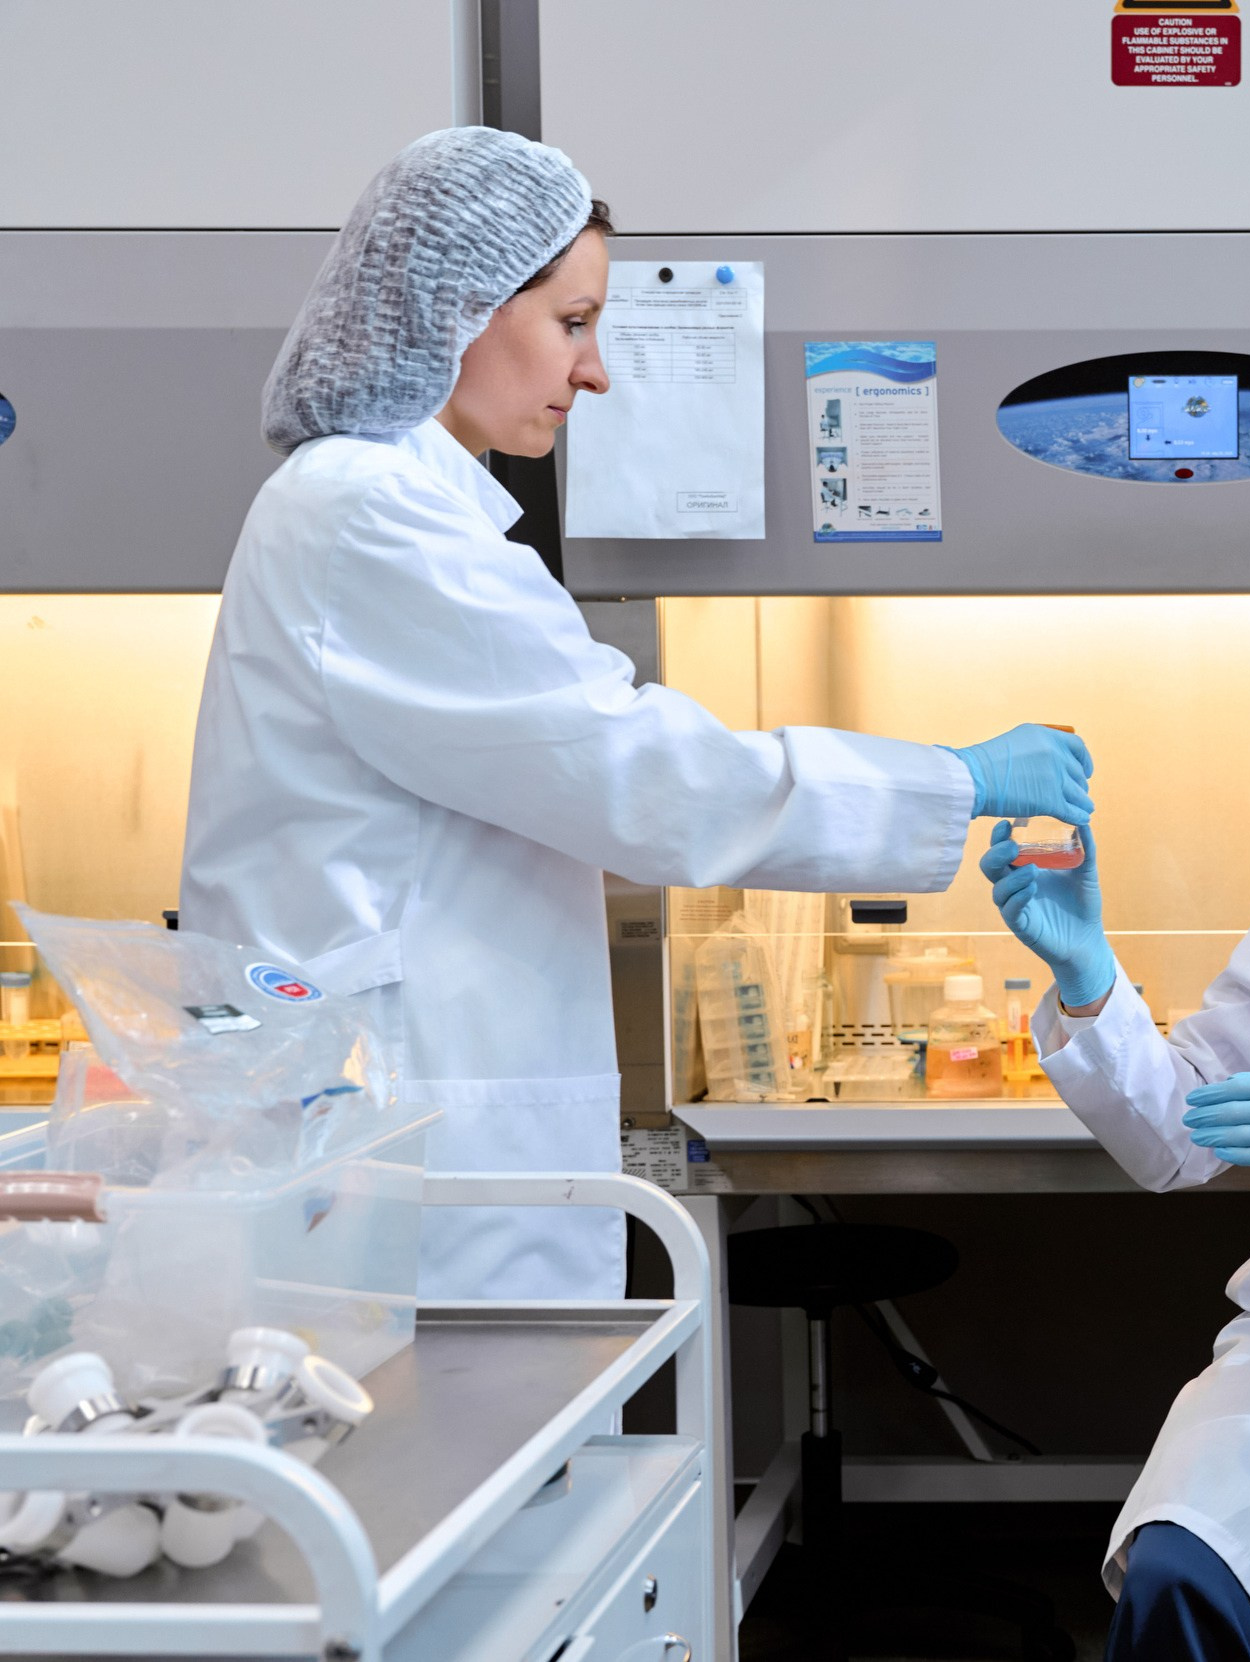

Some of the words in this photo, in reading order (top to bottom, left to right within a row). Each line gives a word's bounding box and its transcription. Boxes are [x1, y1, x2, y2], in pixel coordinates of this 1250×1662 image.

[1158, 18, 1193, 26] CAUTION
[1122, 37, 1168, 45] FLAMMABLE
[1170, 37, 1219, 45] SUBSTANCES
[1220, 37, 1228, 45] IN
[1135, 56, 1179, 64] EVALUATED
[1180, 56, 1191, 64] BY
[1192, 56, 1214, 64] YOUR
[1134, 65, 1186, 73] APPROPRIATE
[1187, 65, 1216, 73] SAFETY
[1151, 75, 1199, 83] PERSONNEL.
[814, 386, 852, 395] experience
[863, 386, 922, 397] ergonomics
